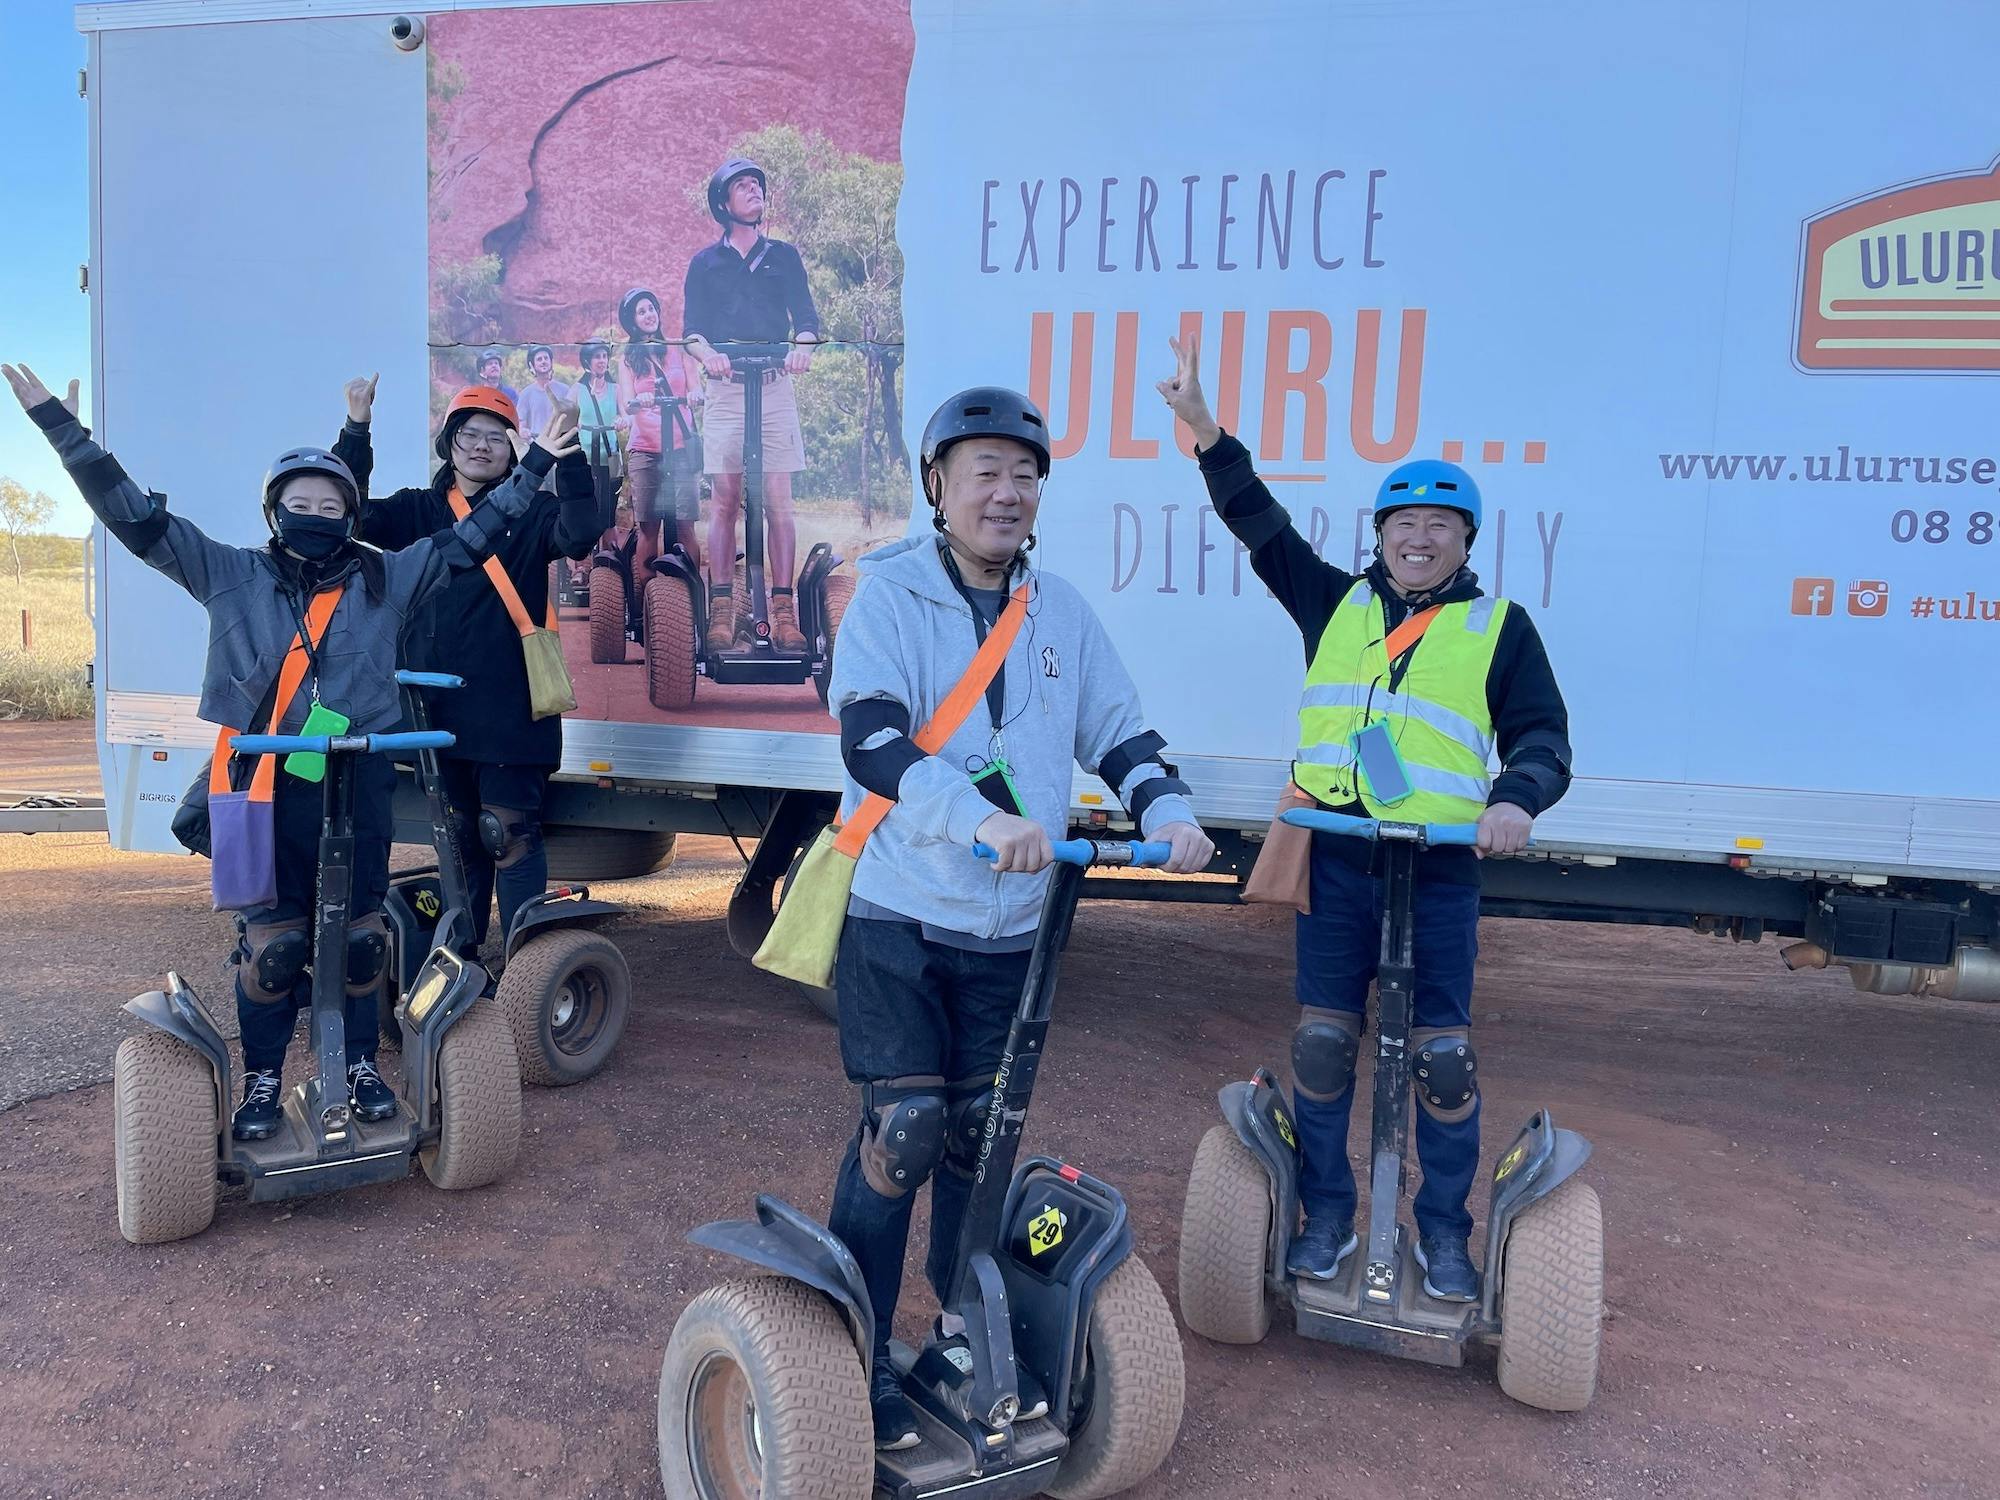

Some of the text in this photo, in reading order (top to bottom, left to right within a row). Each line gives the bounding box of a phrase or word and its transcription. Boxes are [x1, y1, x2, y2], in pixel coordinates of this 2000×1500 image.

[980, 168, 1387, 274] EXPERIENCE
[1658, 446, 2000, 485] www.uluruse
[1891, 509, 2000, 545] 08 8
[139, 792, 176, 803] BIGRIGS
[418, 896, 437, 912] 10
[1031, 1217, 1059, 1246] 29
